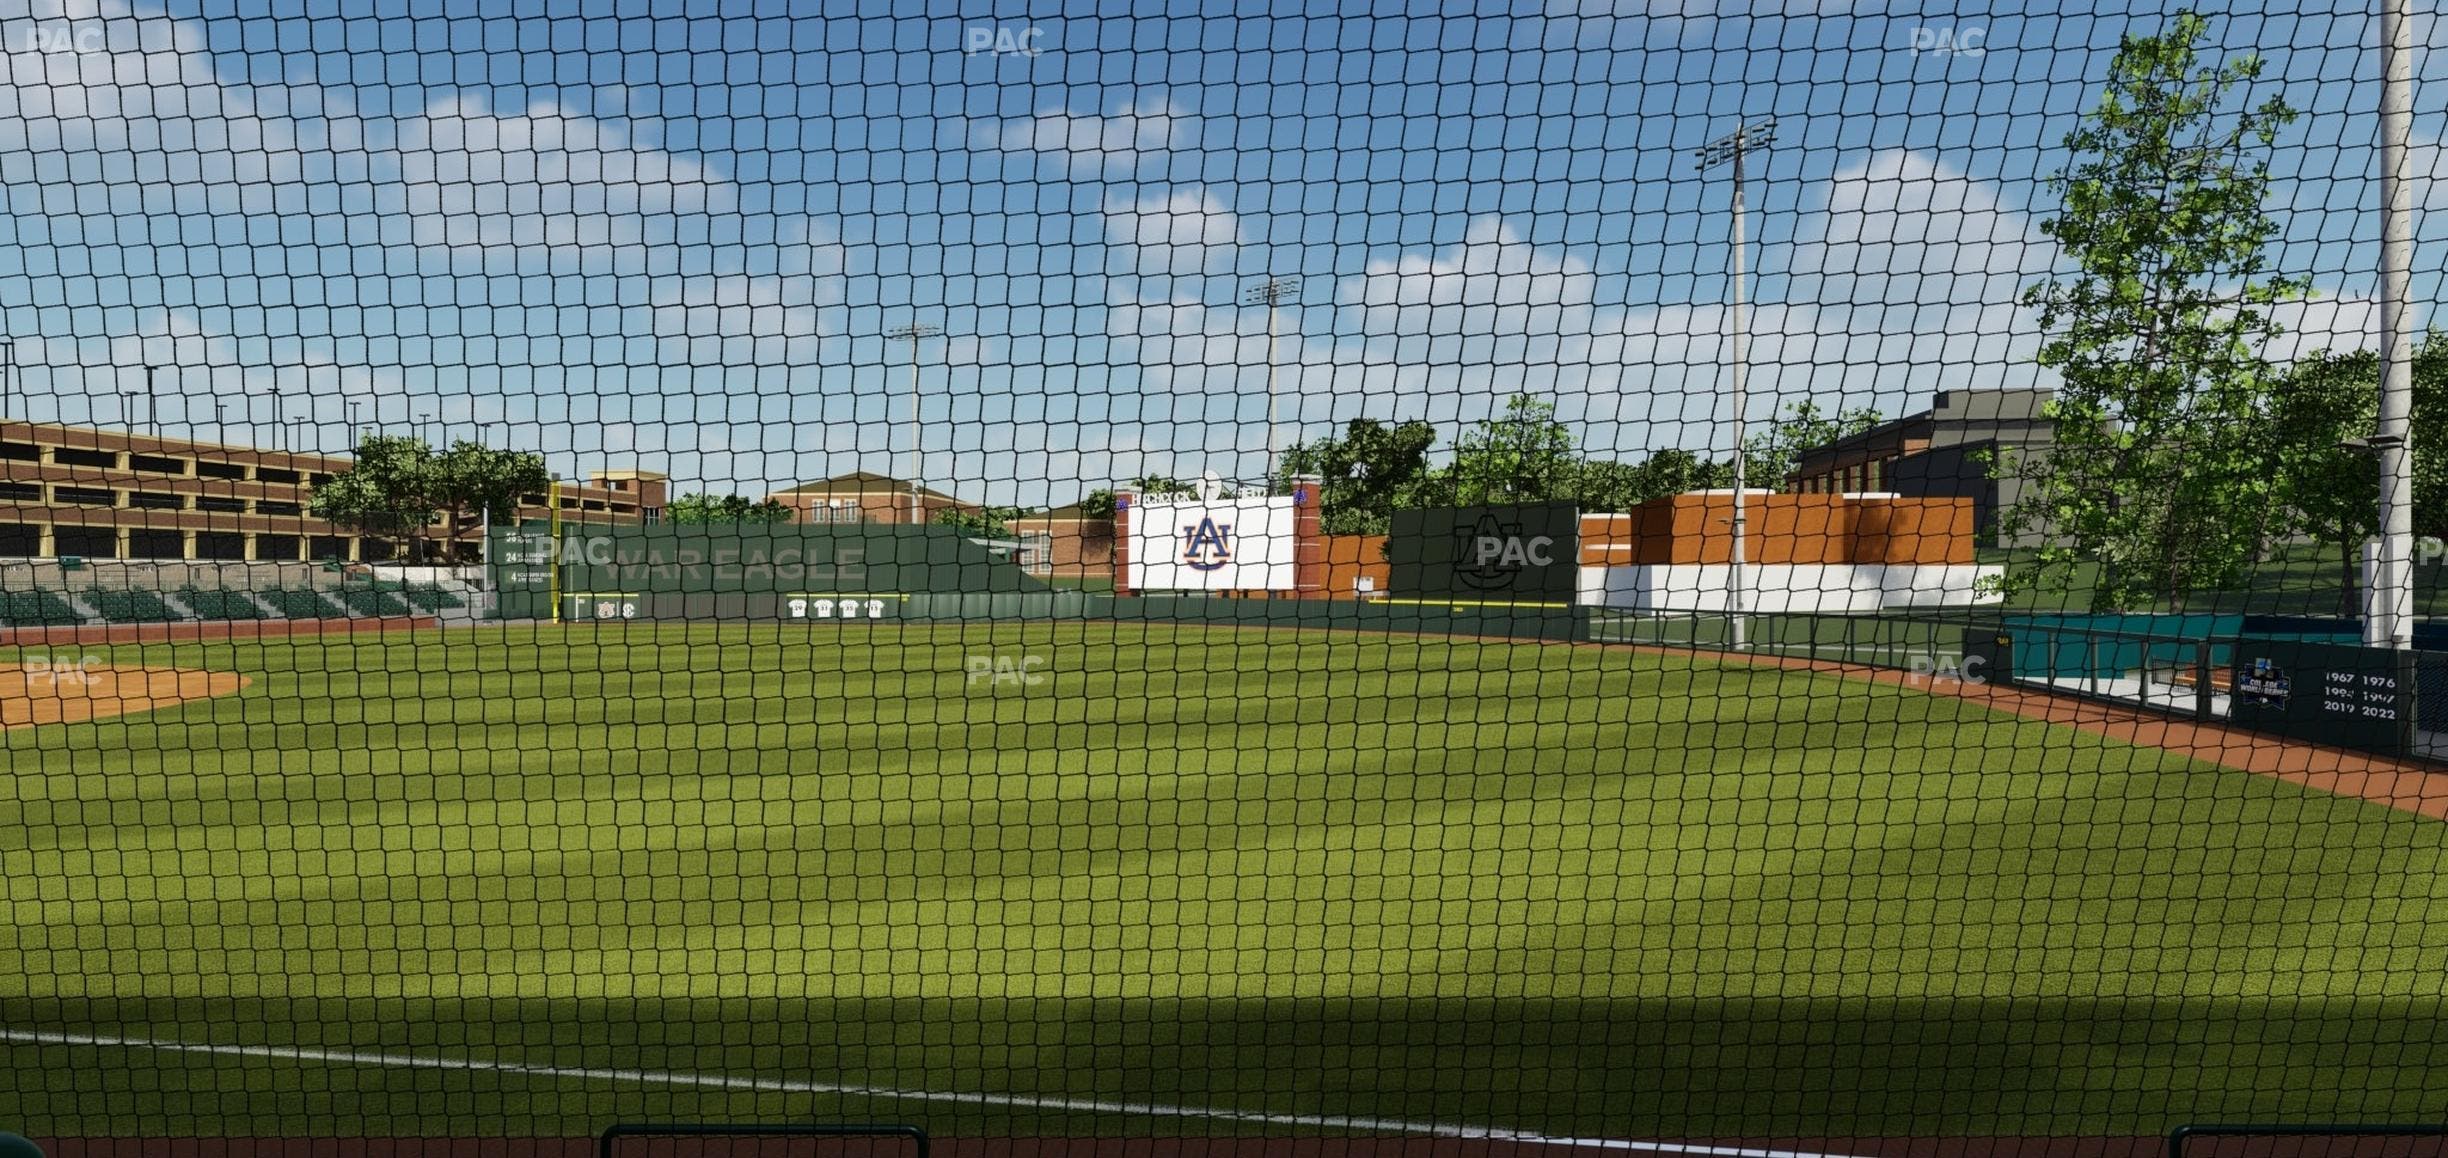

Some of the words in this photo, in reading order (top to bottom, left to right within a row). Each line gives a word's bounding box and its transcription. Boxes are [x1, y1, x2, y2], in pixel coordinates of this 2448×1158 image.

[506, 552, 517, 562] 24
[600, 549, 702, 580] WAR
[715, 549, 866, 580] EAGLE
[511, 572, 517, 582] 4
[2325, 672, 2355, 683] 1967
[2363, 675, 2396, 688] 1976
[2324, 700, 2355, 713] 2019
[2362, 705, 2396, 720] 2022
